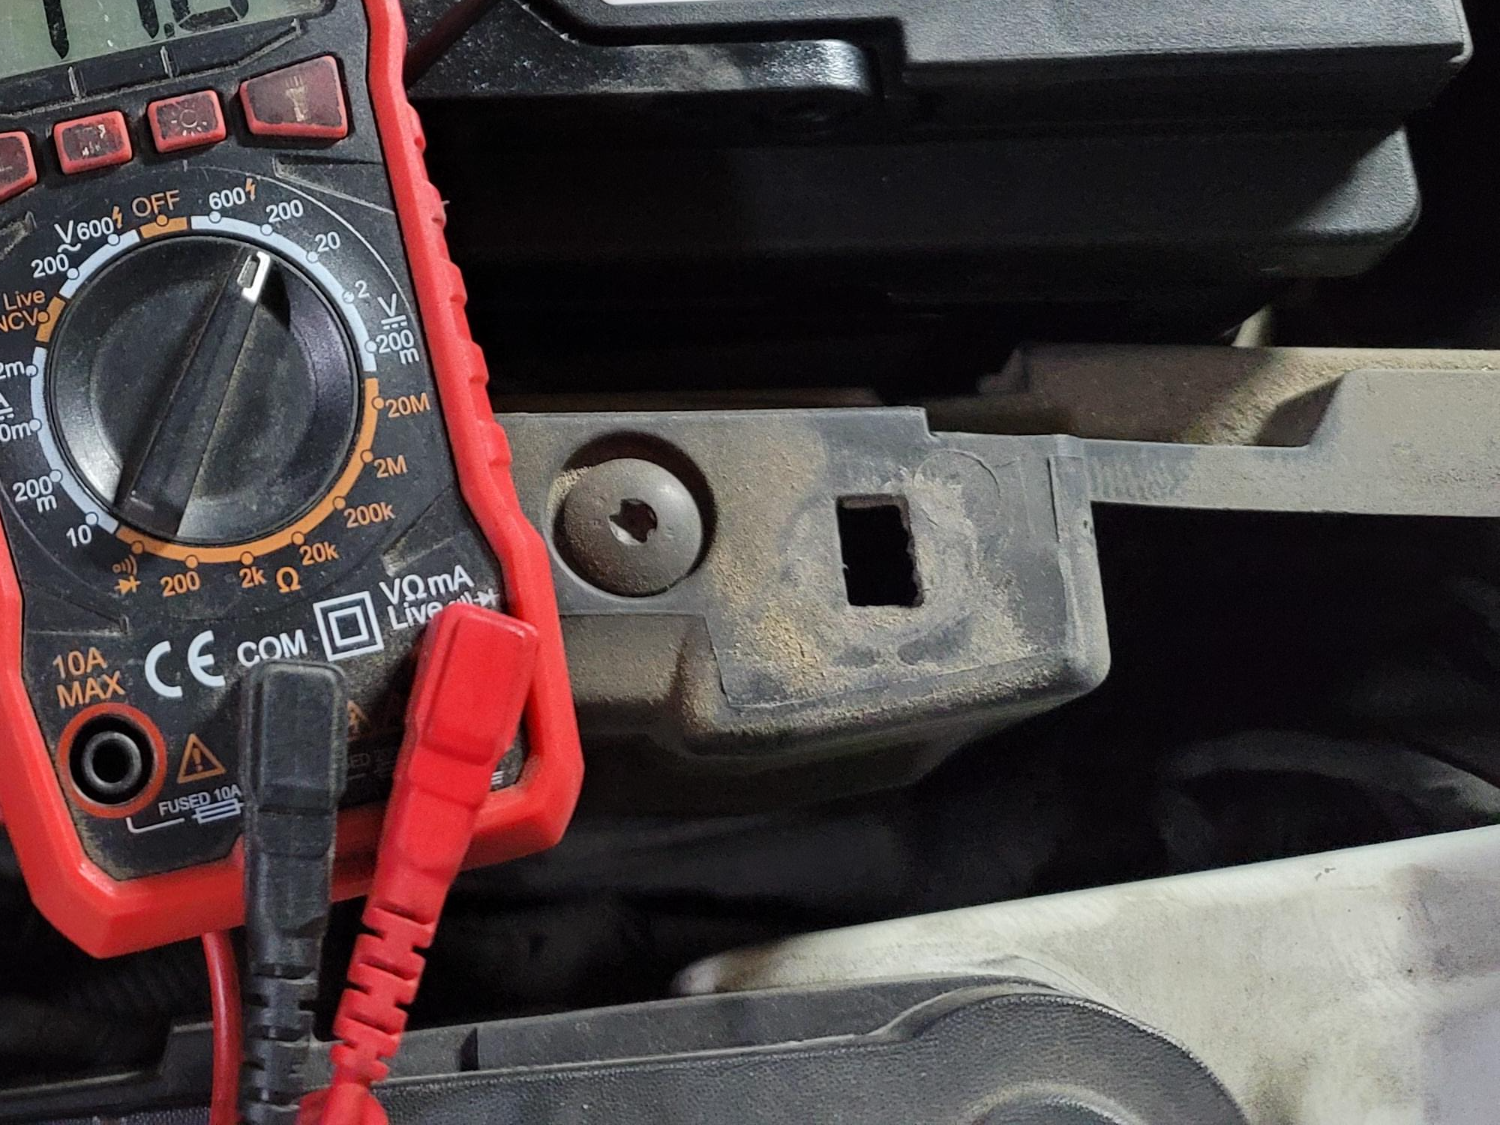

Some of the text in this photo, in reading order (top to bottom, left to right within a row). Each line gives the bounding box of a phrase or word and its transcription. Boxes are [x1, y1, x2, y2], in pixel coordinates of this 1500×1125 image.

[132, 189, 181, 218] OFF
[208, 186, 246, 210] 600
[265, 199, 304, 224] 200
[53, 220, 74, 244] V
[76, 216, 115, 241] 600
[314, 231, 341, 253] 20
[30, 253, 70, 279] 200
[2, 289, 46, 311] Live
[354, 279, 371, 300] 2
[377, 292, 397, 317] V
[375, 328, 415, 354] 200
[399, 346, 420, 366] m
[385, 393, 431, 418] 20M
[373, 454, 408, 479] 2M
[12, 475, 53, 503] 200
[36, 495, 58, 514] m
[343, 501, 396, 528] 200k
[65, 524, 93, 548] 10
[299, 541, 339, 566] 20k
[159, 570, 201, 597] 200
[239, 565, 267, 589] 2k
[275, 566, 301, 594] Ω
[386, 600, 443, 631] Live
[237, 628, 308, 668] COM
[52, 646, 108, 679] 10A
[144, 629, 226, 698] CE
[56, 670, 126, 709] MAX
[158, 784, 242, 817] FUSED 10A
